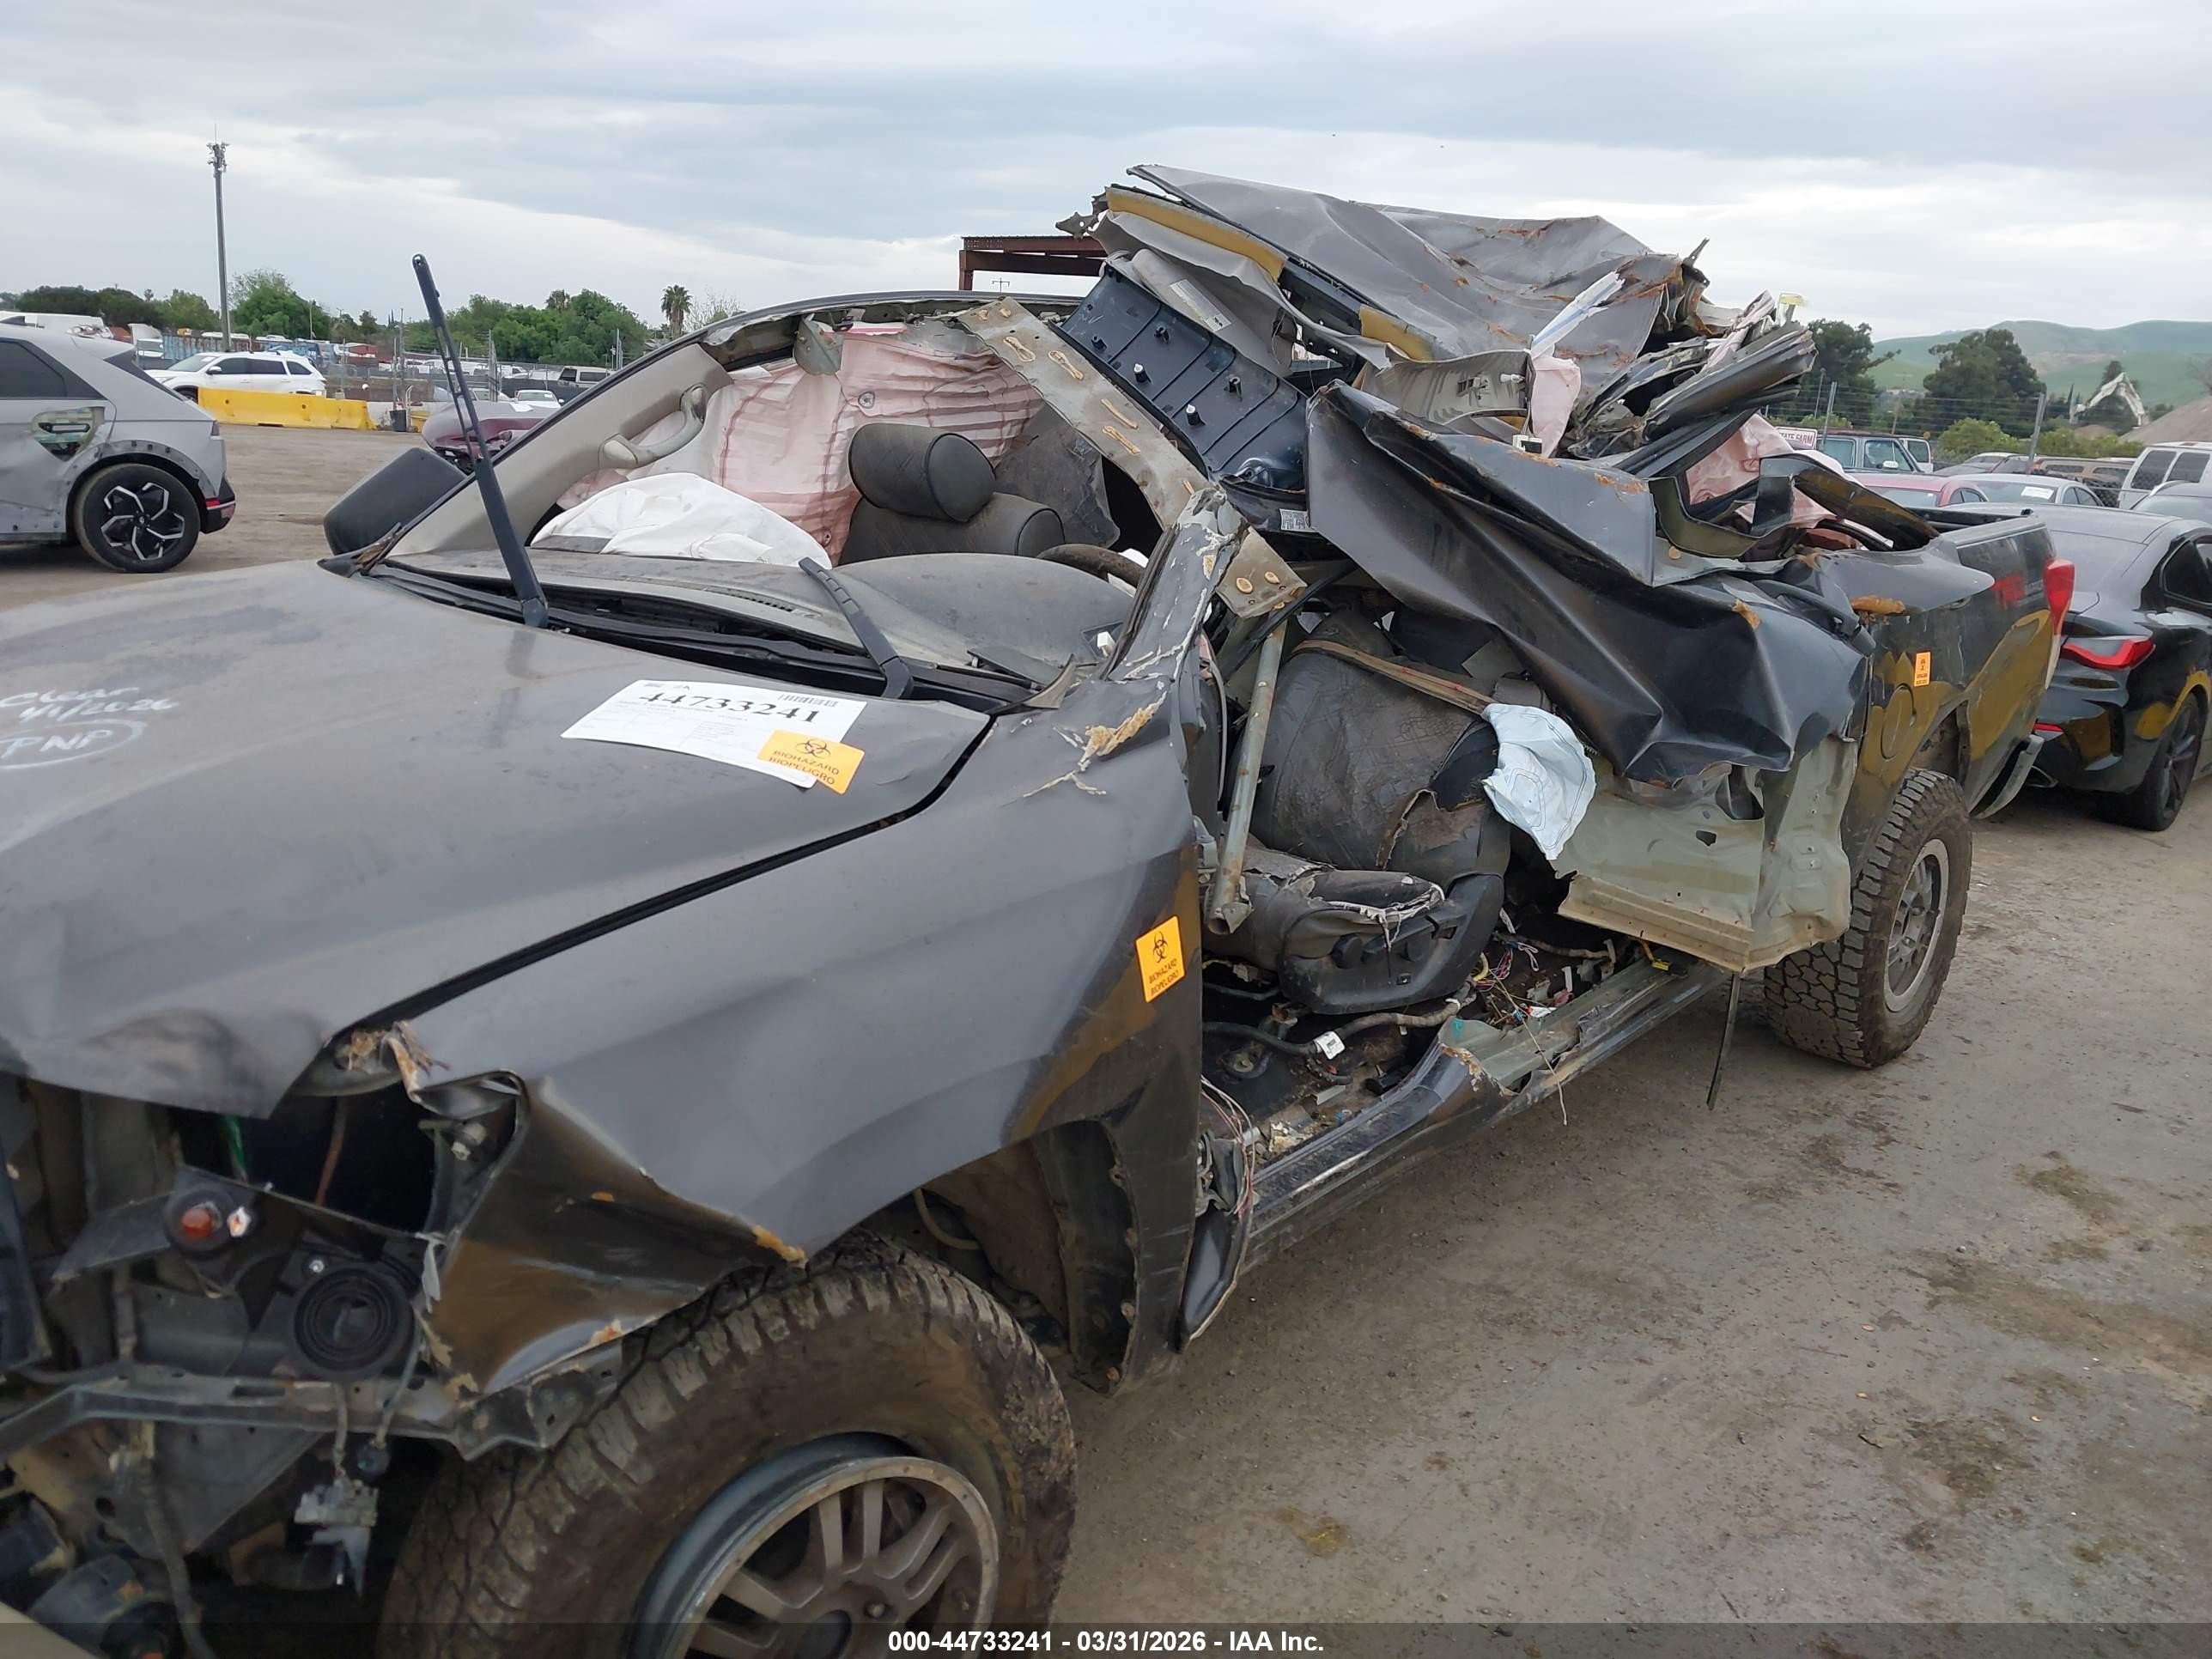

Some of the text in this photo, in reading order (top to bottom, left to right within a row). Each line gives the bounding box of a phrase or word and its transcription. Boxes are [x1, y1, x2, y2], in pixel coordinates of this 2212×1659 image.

[639, 692, 819, 722] 44733241
[769, 757, 836, 785] BIOPELIGRO
[773, 750, 840, 775] BIOHAZARD
